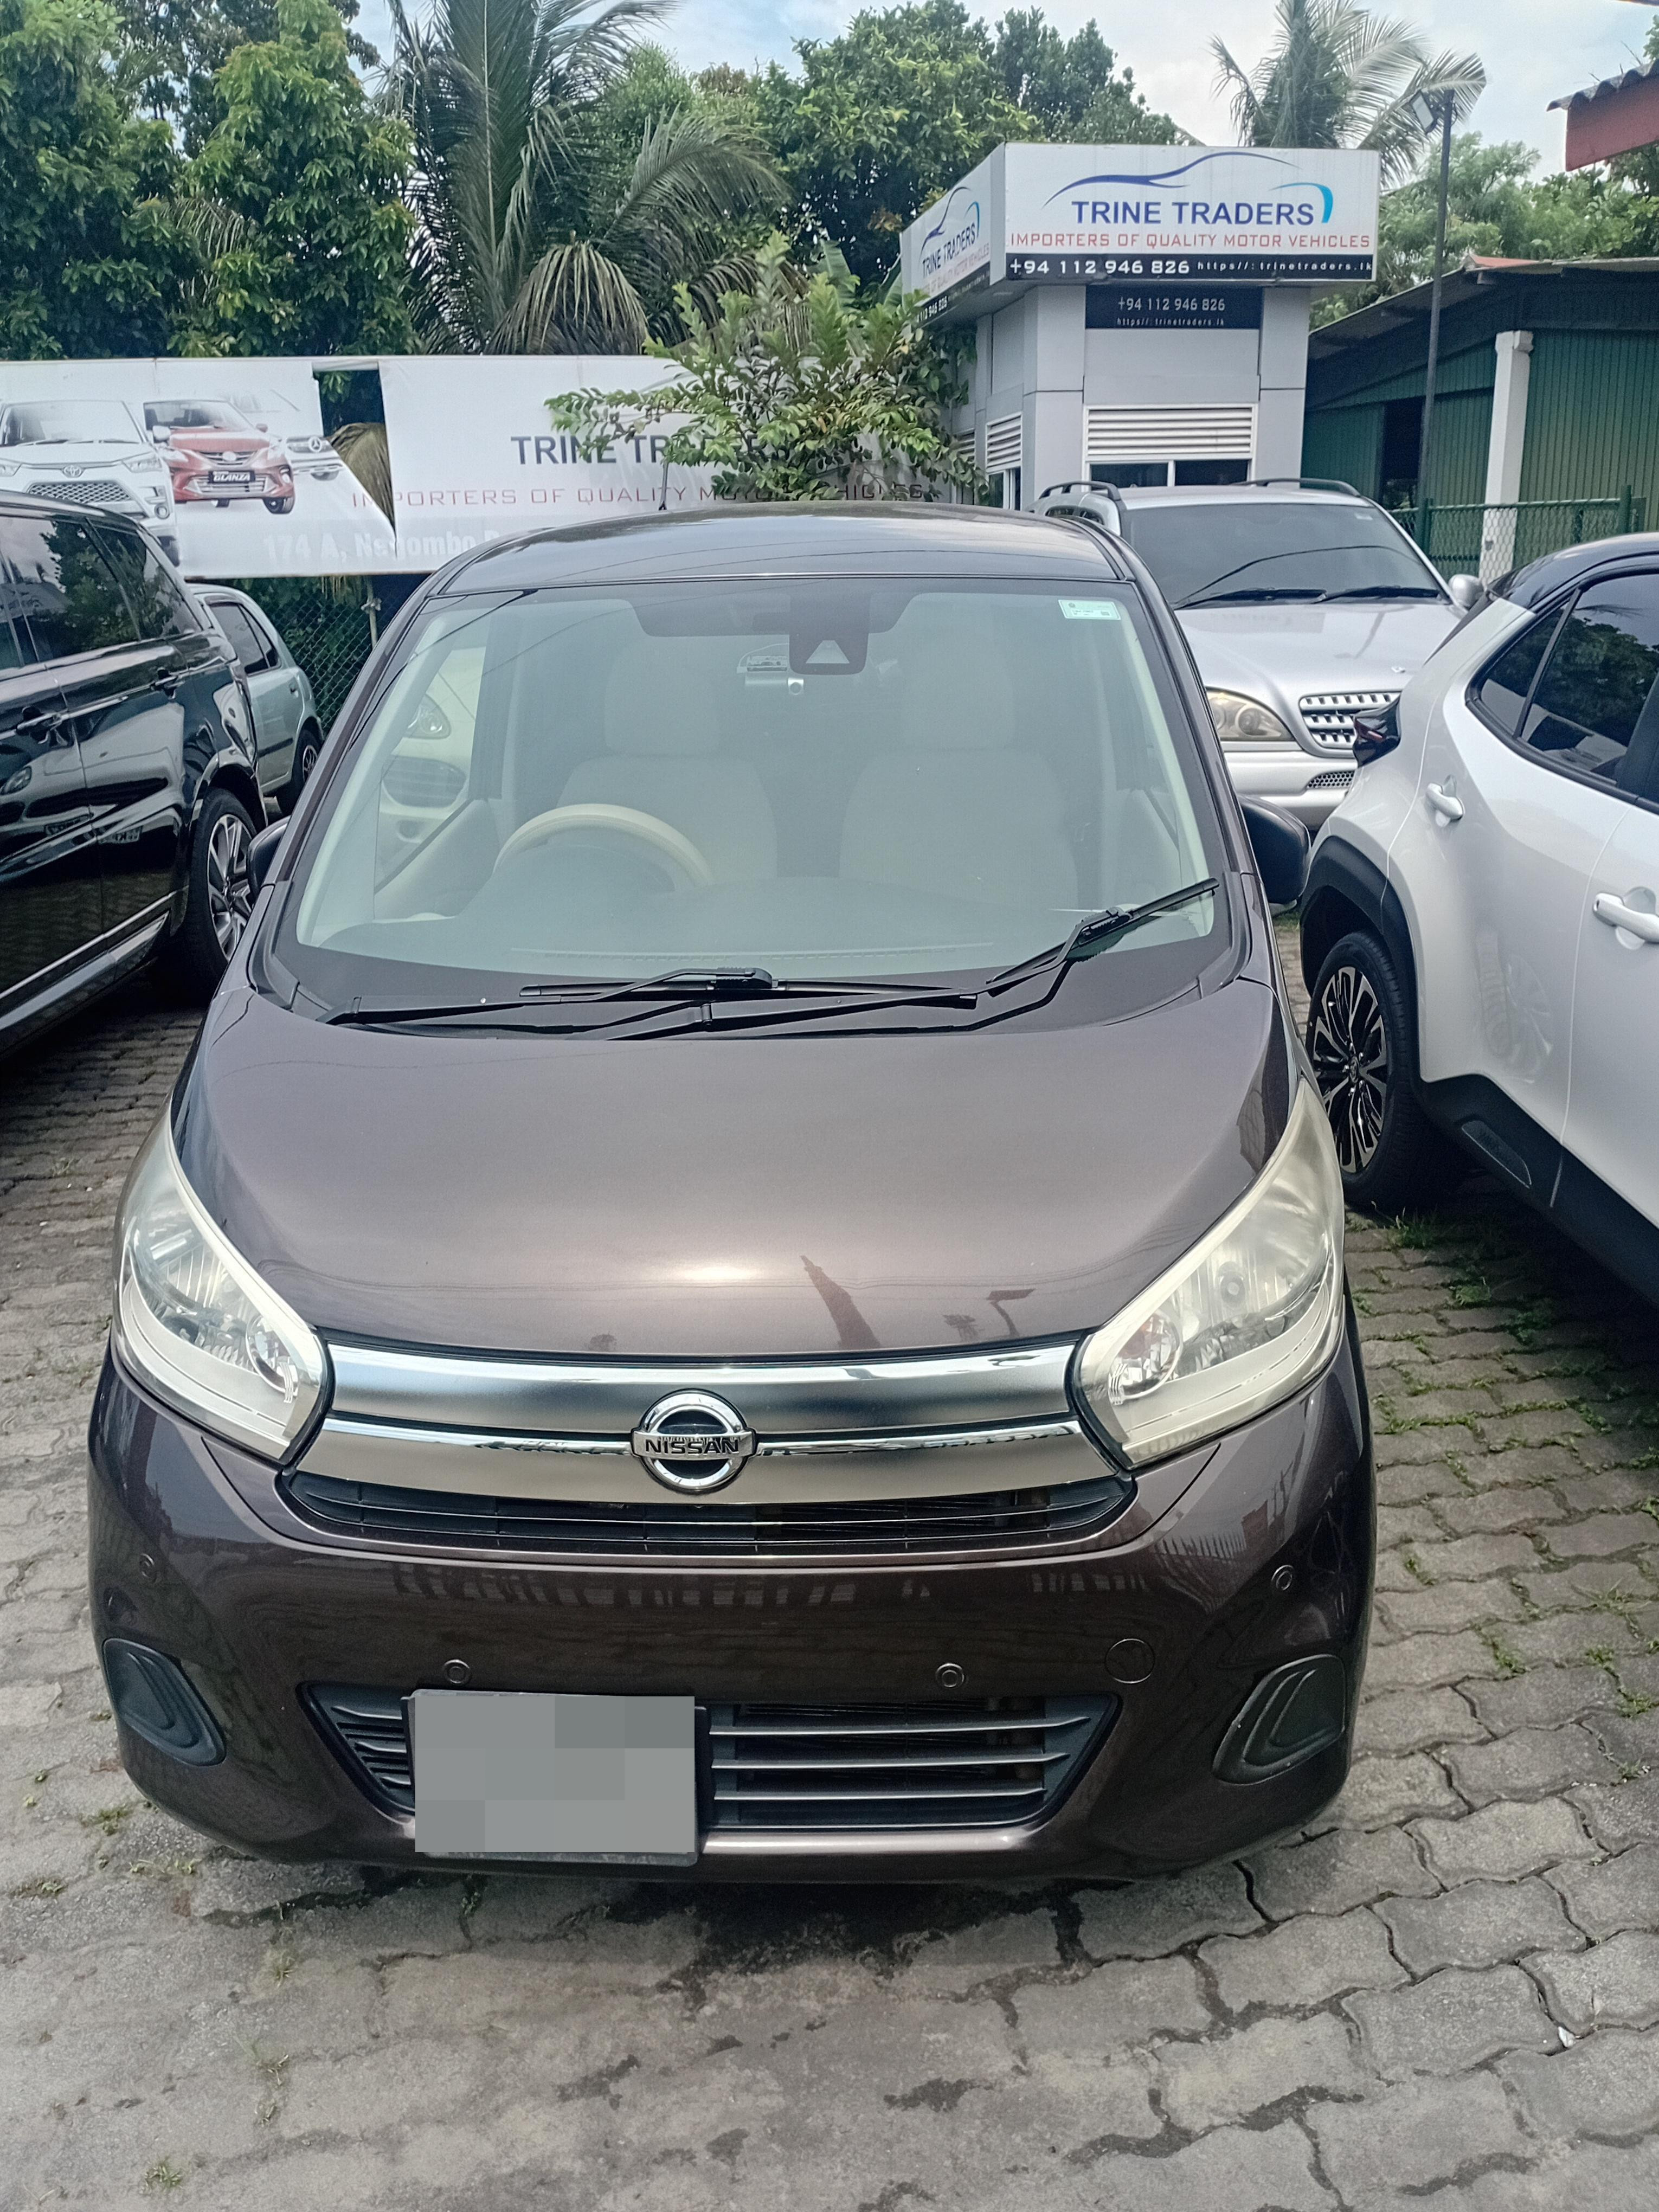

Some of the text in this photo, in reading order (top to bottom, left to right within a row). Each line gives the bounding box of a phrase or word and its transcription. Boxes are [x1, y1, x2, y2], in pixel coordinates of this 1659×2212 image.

[1071, 201, 1314, 226] TRINE TRADERS
[1011, 233, 1370, 249] IMPORTERS OF QUALITY MOTOR VEHICLES
[923, 222, 975, 278] TRINE TRADERS
[1010, 258, 1050, 274] +94
[1060, 260, 1097, 274] 112
[1104, 260, 1143, 274] 946
[1151, 260, 1190, 274] 826
[1118, 297, 1225, 311] +94 112 946 826
[511, 435, 617, 465] TRINE
[213, 473, 250, 483] GLANZA
[531, 488, 565, 504] OF
[263, 534, 312, 561] 174
[645, 1438, 739, 1455] NISSAN
